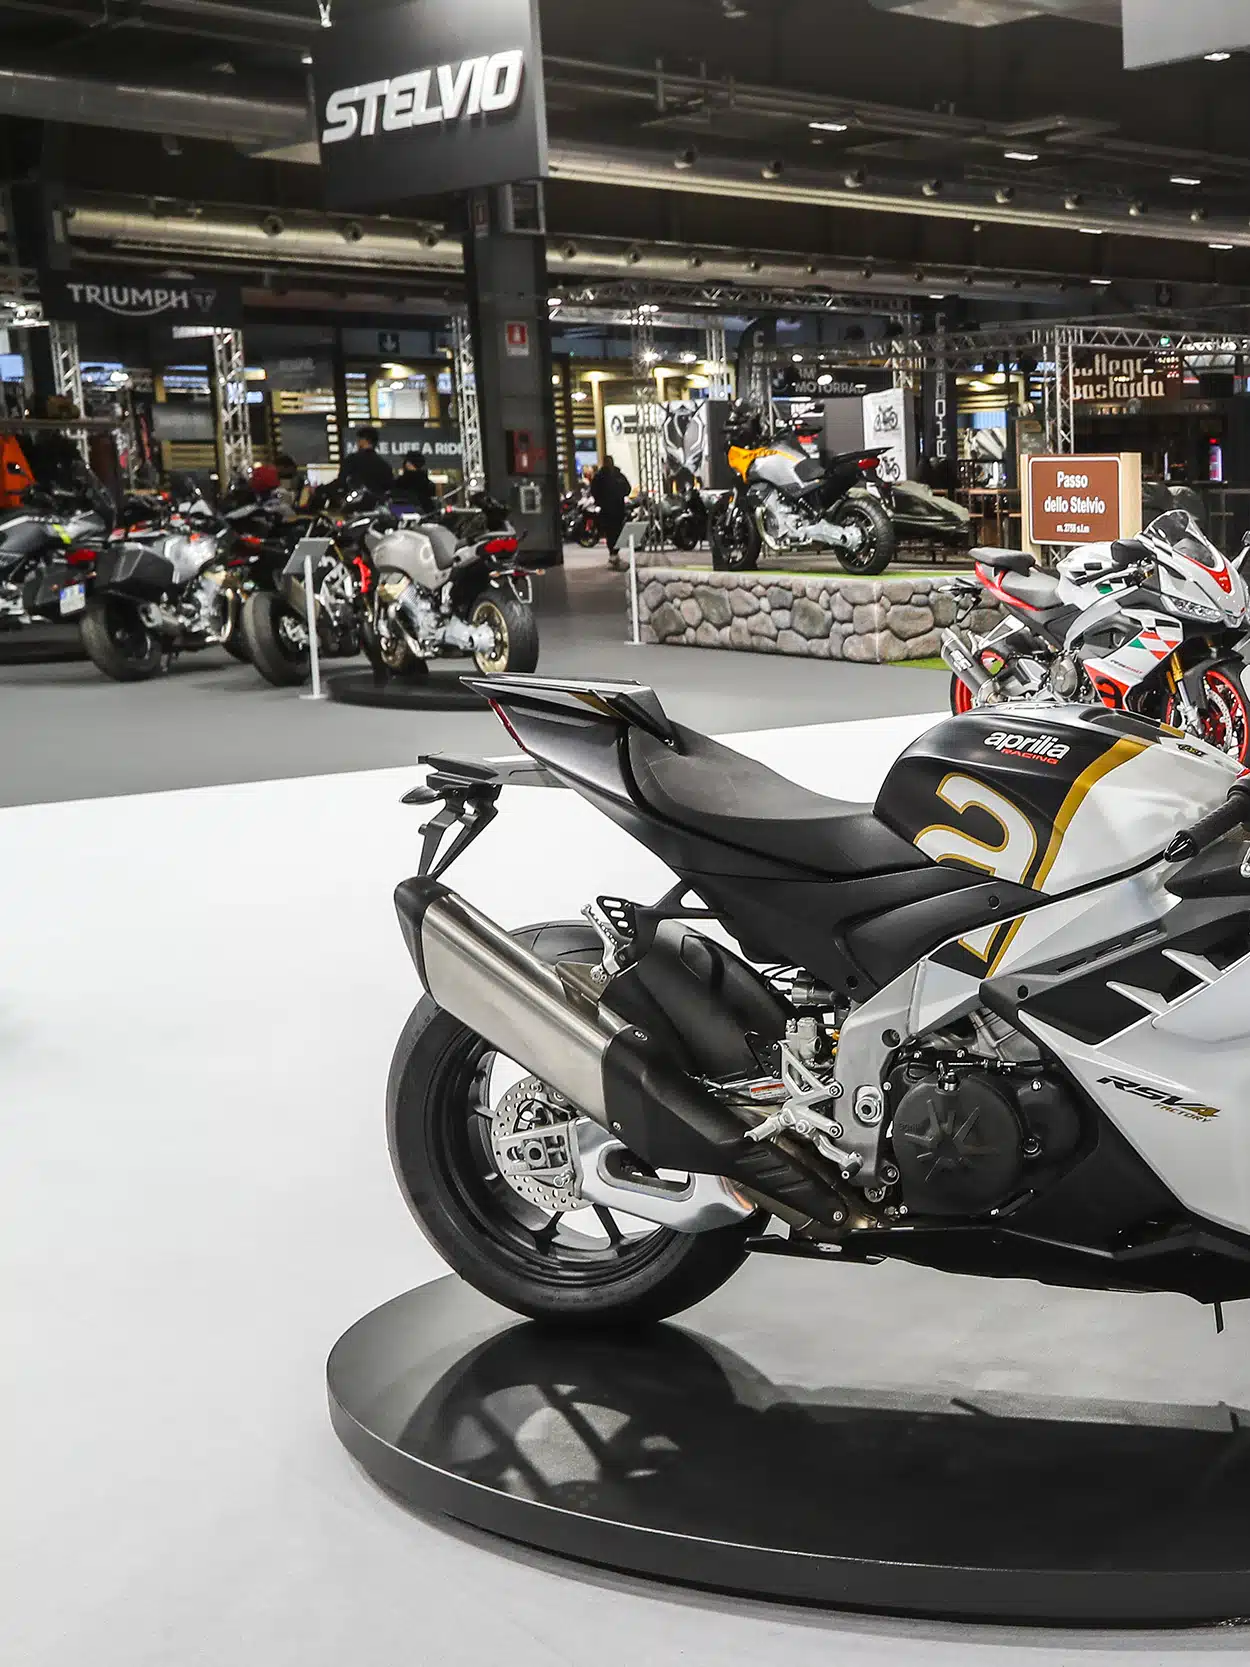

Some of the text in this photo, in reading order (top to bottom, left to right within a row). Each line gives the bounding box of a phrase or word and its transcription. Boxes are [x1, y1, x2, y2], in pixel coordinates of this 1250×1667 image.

[322, 50, 524, 144] STELVIO
[66, 283, 190, 315] TRIUMPH
[1056, 471, 1089, 489] Passo
[1044, 496, 1106, 514] dello Stelvio
[984, 731, 1071, 760] aprilia
[1001, 748, 1059, 765] RACING
[1096, 1075, 1221, 1118] RSV4
[1153, 1103, 1212, 1123] FACTORY
